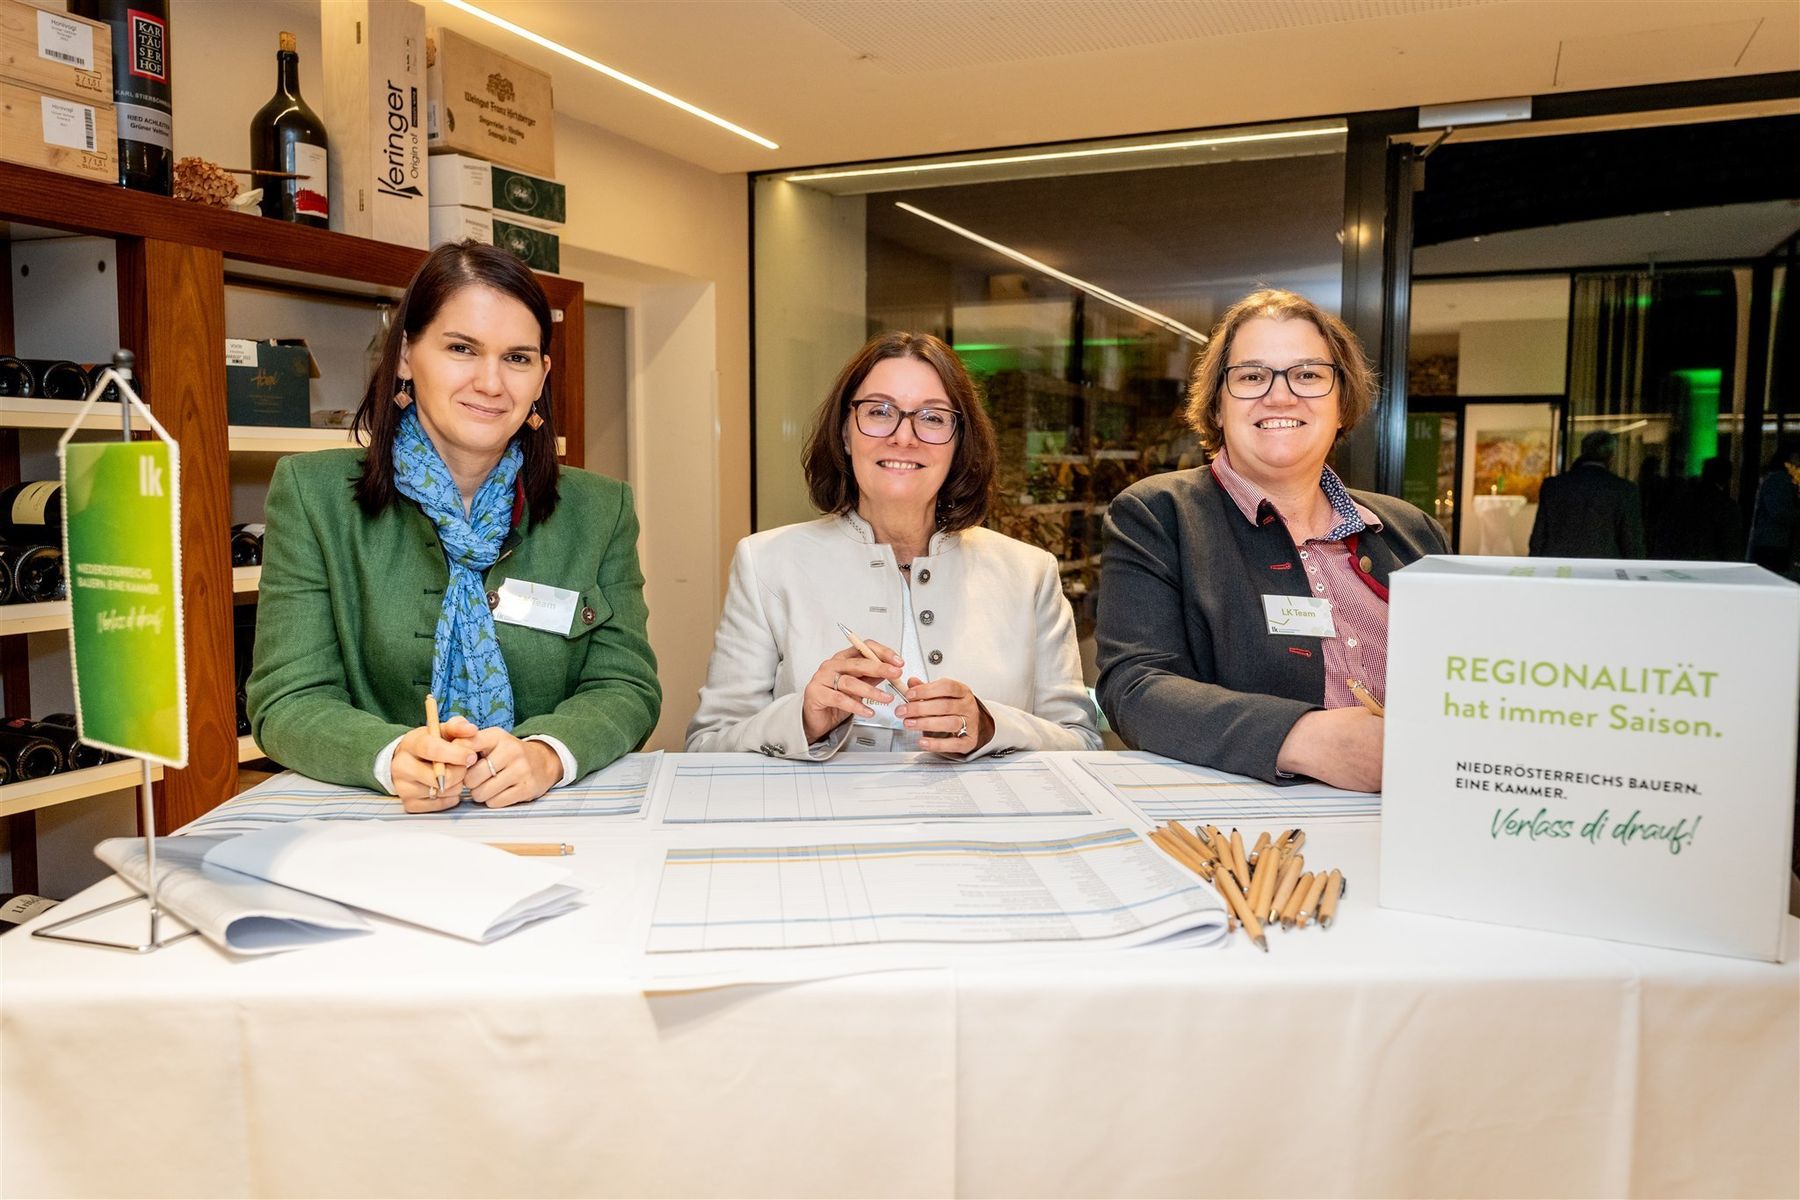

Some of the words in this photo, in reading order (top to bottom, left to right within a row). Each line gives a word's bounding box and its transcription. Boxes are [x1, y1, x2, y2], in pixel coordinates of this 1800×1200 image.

[139, 22, 160, 37] KAR
[139, 34, 160, 49] TÄU
[139, 47, 161, 61] SER
[140, 60, 162, 73] HOF
[410, 133, 419, 145] of
[411, 141, 420, 179] Origin
[139, 455, 164, 497] lk
[1282, 608, 1293, 617] LK
[1293, 608, 1316, 618] Team
[1446, 656, 1719, 698] REGIONALITÄT
[1444, 692, 1489, 719] hat
[1499, 697, 1598, 727] immer
[1609, 704, 1723, 738] Saison.
[1456, 761, 1623, 788] NIEDERÖSTERREICHS
[1629, 777, 1702, 796] BAUERN.
[1456, 778, 1490, 792] EINE
[1494, 782, 1567, 800] KAMMER.
[1491, 808, 1574, 842] Verlass
[1580, 809, 1609, 846] di
[1611, 809, 1703, 855] drauf!
